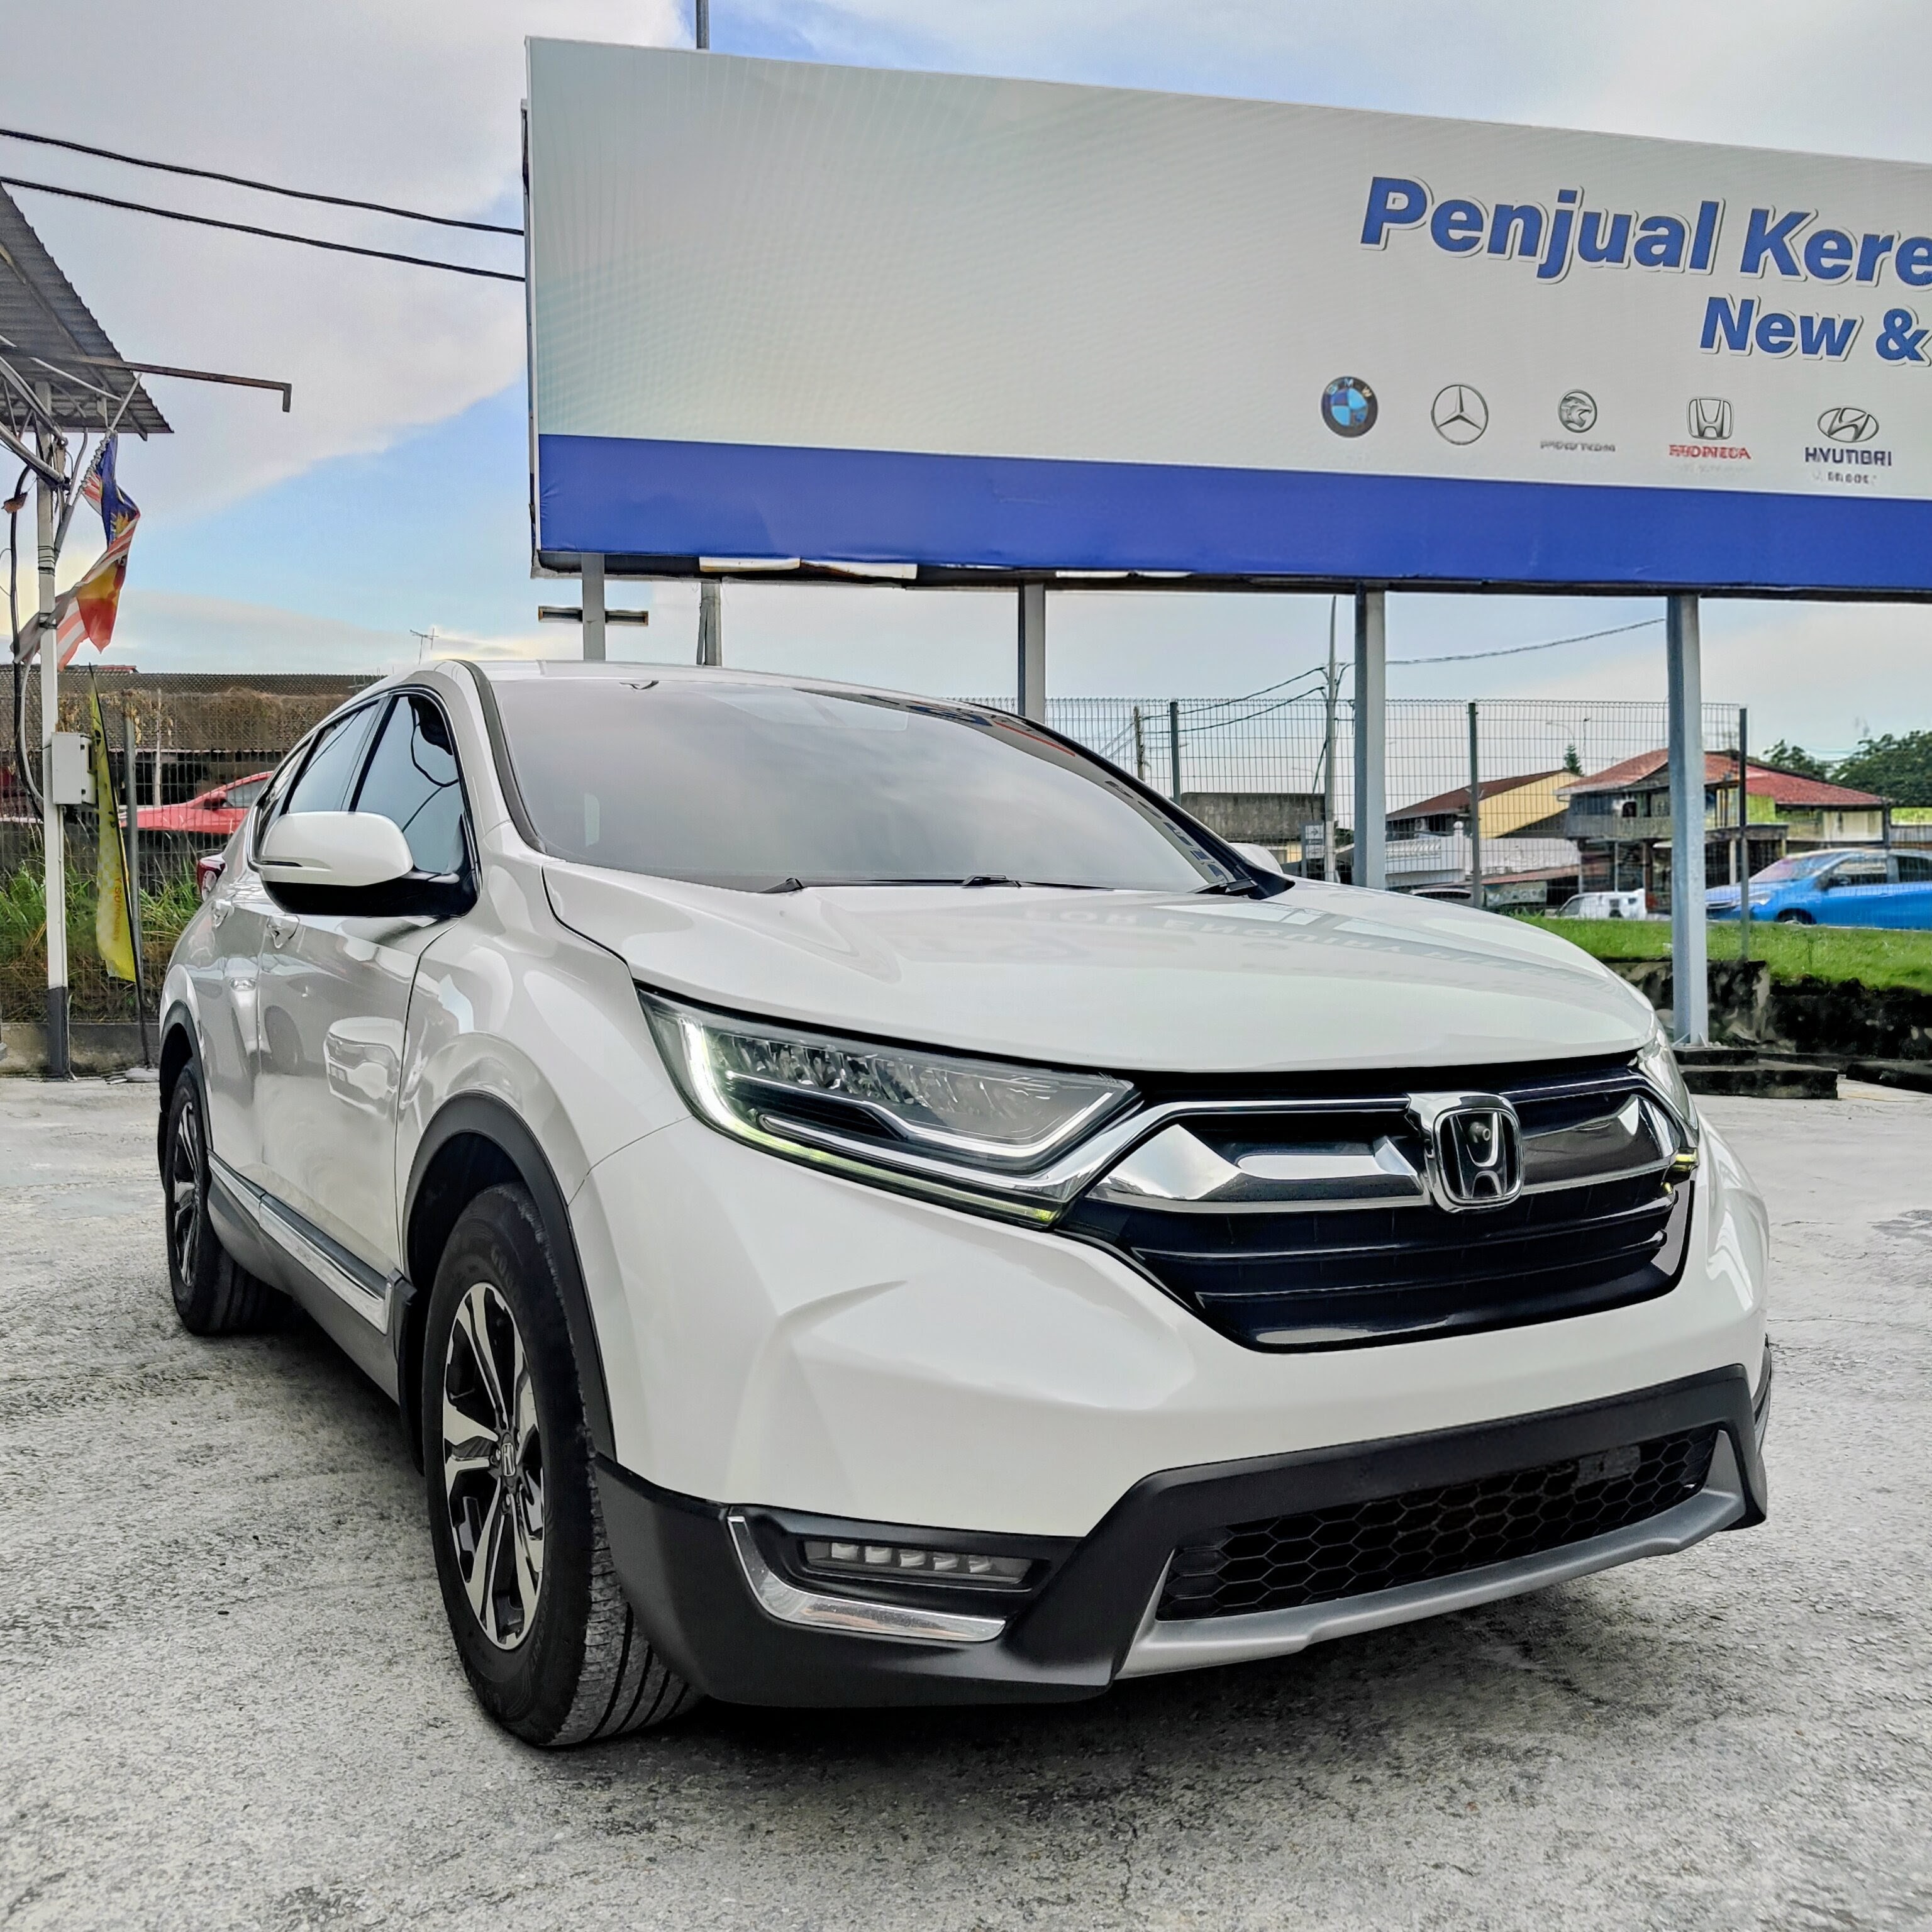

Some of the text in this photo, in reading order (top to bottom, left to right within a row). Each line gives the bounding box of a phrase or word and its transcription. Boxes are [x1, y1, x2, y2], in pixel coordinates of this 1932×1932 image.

[1360, 175, 1932, 287] Penjual Kere
[1699, 296, 1931, 363] New &
